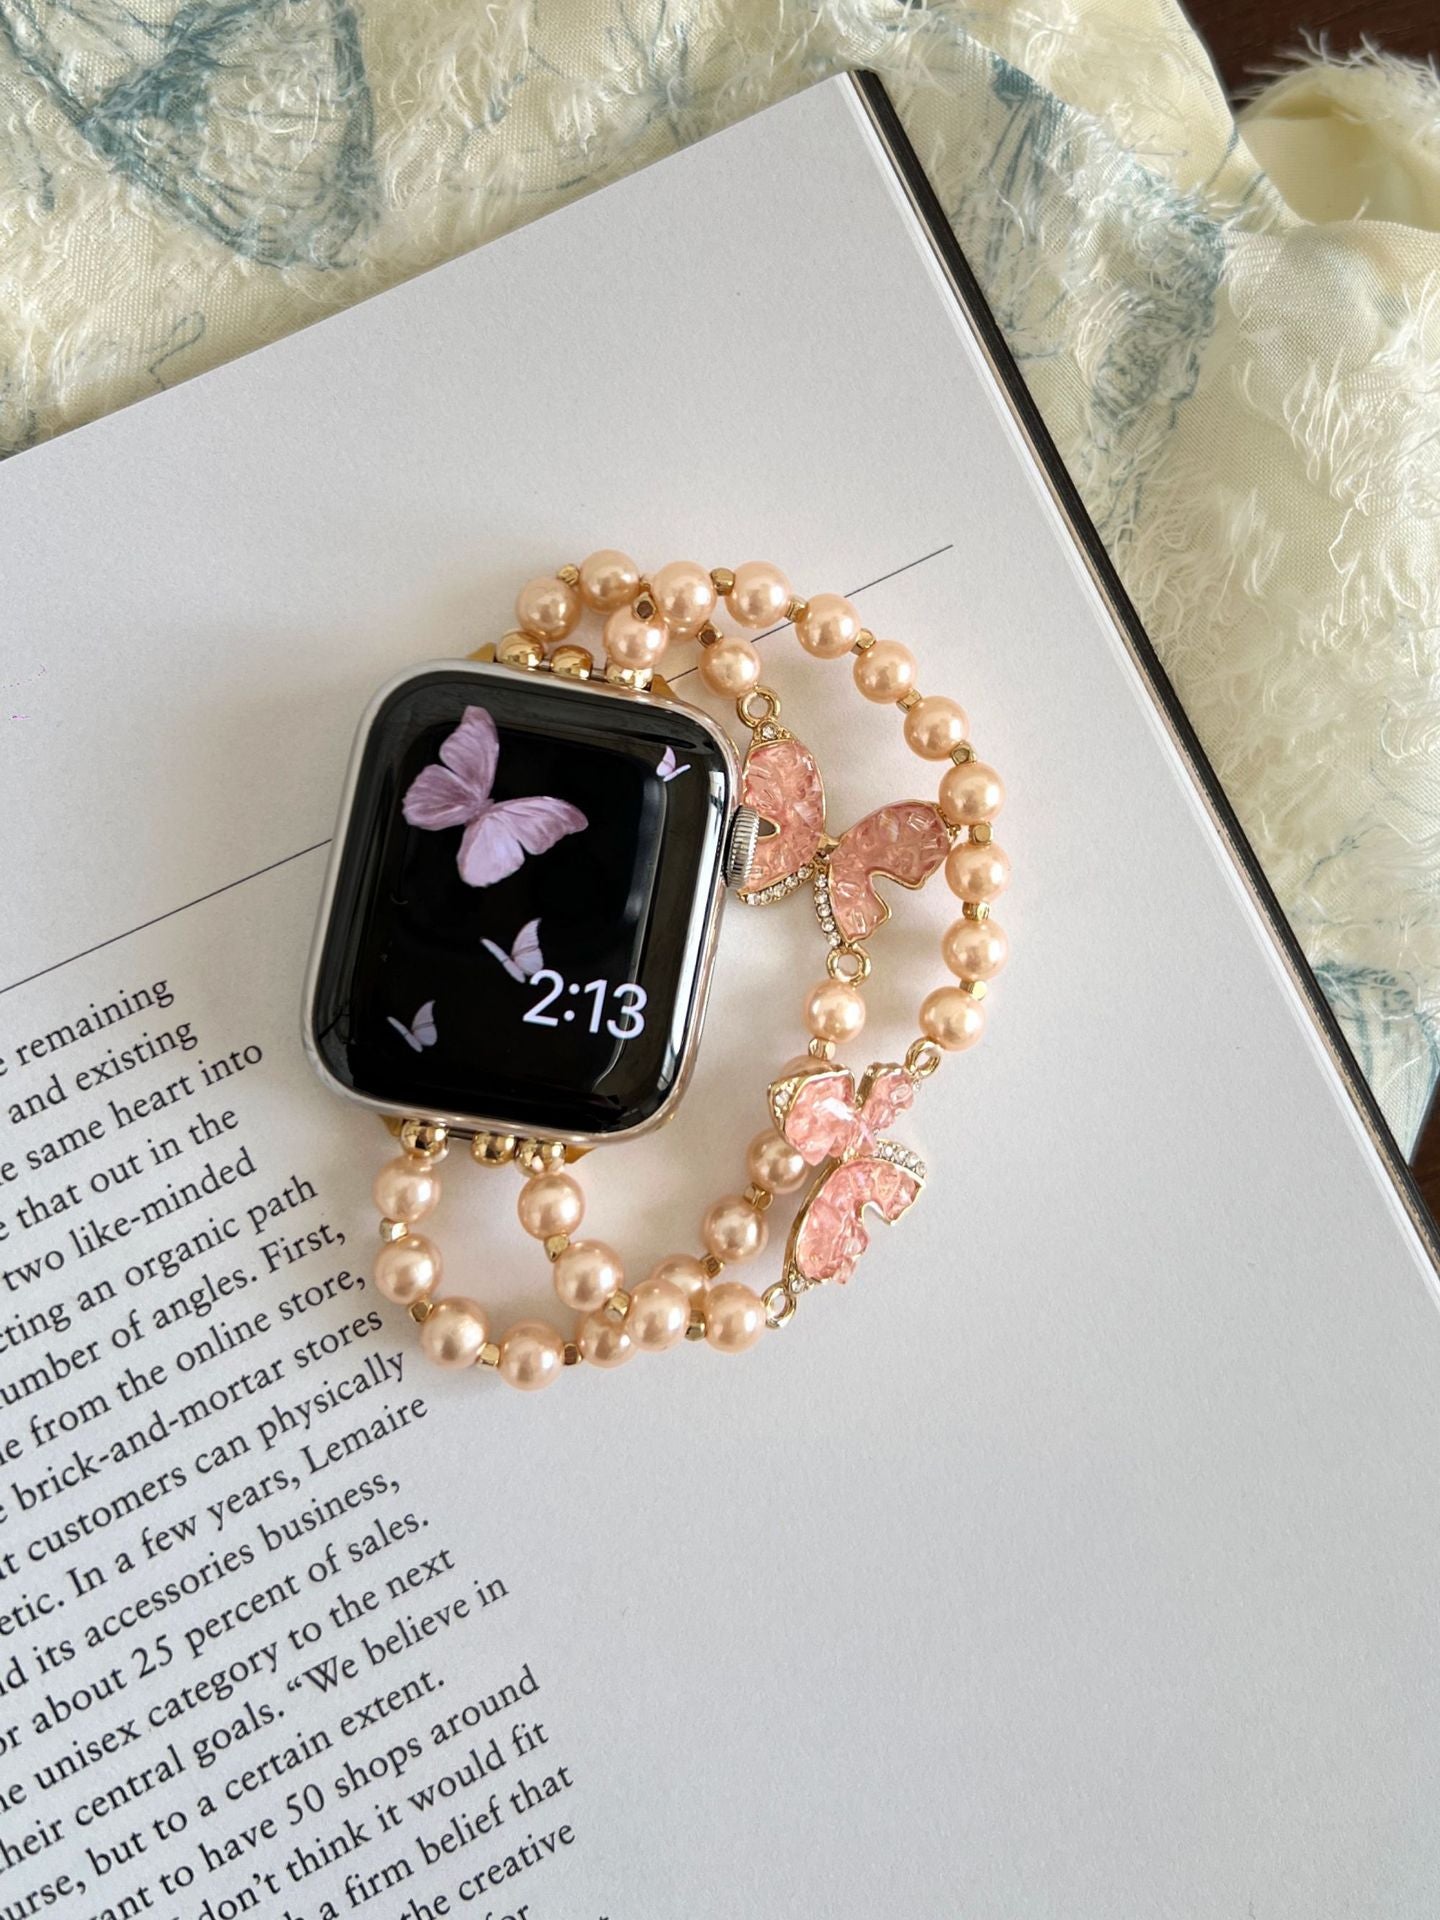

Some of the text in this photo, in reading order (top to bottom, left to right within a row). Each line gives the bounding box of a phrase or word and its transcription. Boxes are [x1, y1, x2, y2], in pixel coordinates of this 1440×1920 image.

[7, 1022, 199, 1125] and existing
[15, 979, 175, 1067] remaining
[523, 970, 647, 1039] 2:13
[15, 1110, 239, 1230] that out in the
[25, 1119, 106, 1171] same
[106, 1075, 196, 1130] heart
[197, 1044, 263, 1087] into
[0, 1145, 258, 1293] two like-minded
[76, 1280, 119, 1313] an
[124, 1217, 241, 1288] organic
[246, 1174, 319, 1236] path
[0, 1223, 346, 1411] umber of angles. First,
[29, 1394, 113, 1449] from
[115, 1365, 168, 1403] the
[175, 1312, 272, 1373] online
[277, 1270, 366, 1322] store,
[9, 1311, 383, 1512] brick-and-mortar stores
[26, 1466, 188, 1563] customers
[194, 1434, 252, 1475] can
[255, 1351, 404, 1452] physically
[65, 1566, 109, 1599] In
[114, 1551, 136, 1575] a
[141, 1514, 197, 1560] few
[205, 1469, 301, 1533] years,
[298, 1398, 428, 1476] Lemaire
[31, 1668, 128, 1735] about
[130, 1633, 174, 1680] 25
[183, 1574, 302, 1660] percent
[307, 1542, 342, 1584] of
[347, 1512, 429, 1564] sales.
[32, 1639, 76, 1676] its
[83, 1543, 255, 1649] accessories
[256, 1473, 401, 1553] business,
[0, 1818, 66, 1876] heir
[74, 1743, 187, 1827] central
[192, 1700, 285, 1770] goals.
[359, 1598, 471, 1667] believe
[473, 1578, 510, 1608] in
[32, 1718, 143, 1791] unisex
[147, 1640, 278, 1728] category
[287, 1621, 323, 1651] to
[328, 1590, 380, 1629] the
[384, 1549, 456, 1600] next
[84, 1831, 149, 1878] but
[151, 1811, 188, 1842] to
[196, 1795, 218, 1818] a
[224, 1730, 334, 1802] certain
[339, 1671, 445, 1738] extent.
[88, 1662, 541, 1920] ant to have 50 shops around
[285, 1818, 373, 1883] think
[374, 1804, 404, 1834] it
[406, 1737, 508, 1812] would
[511, 1722, 550, 1758] fit
[344, 1858, 415, 1909] firm
[414, 1793, 505, 1866] belief
[508, 1766, 574, 1816] that
[458, 1824, 576, 1902] creative
